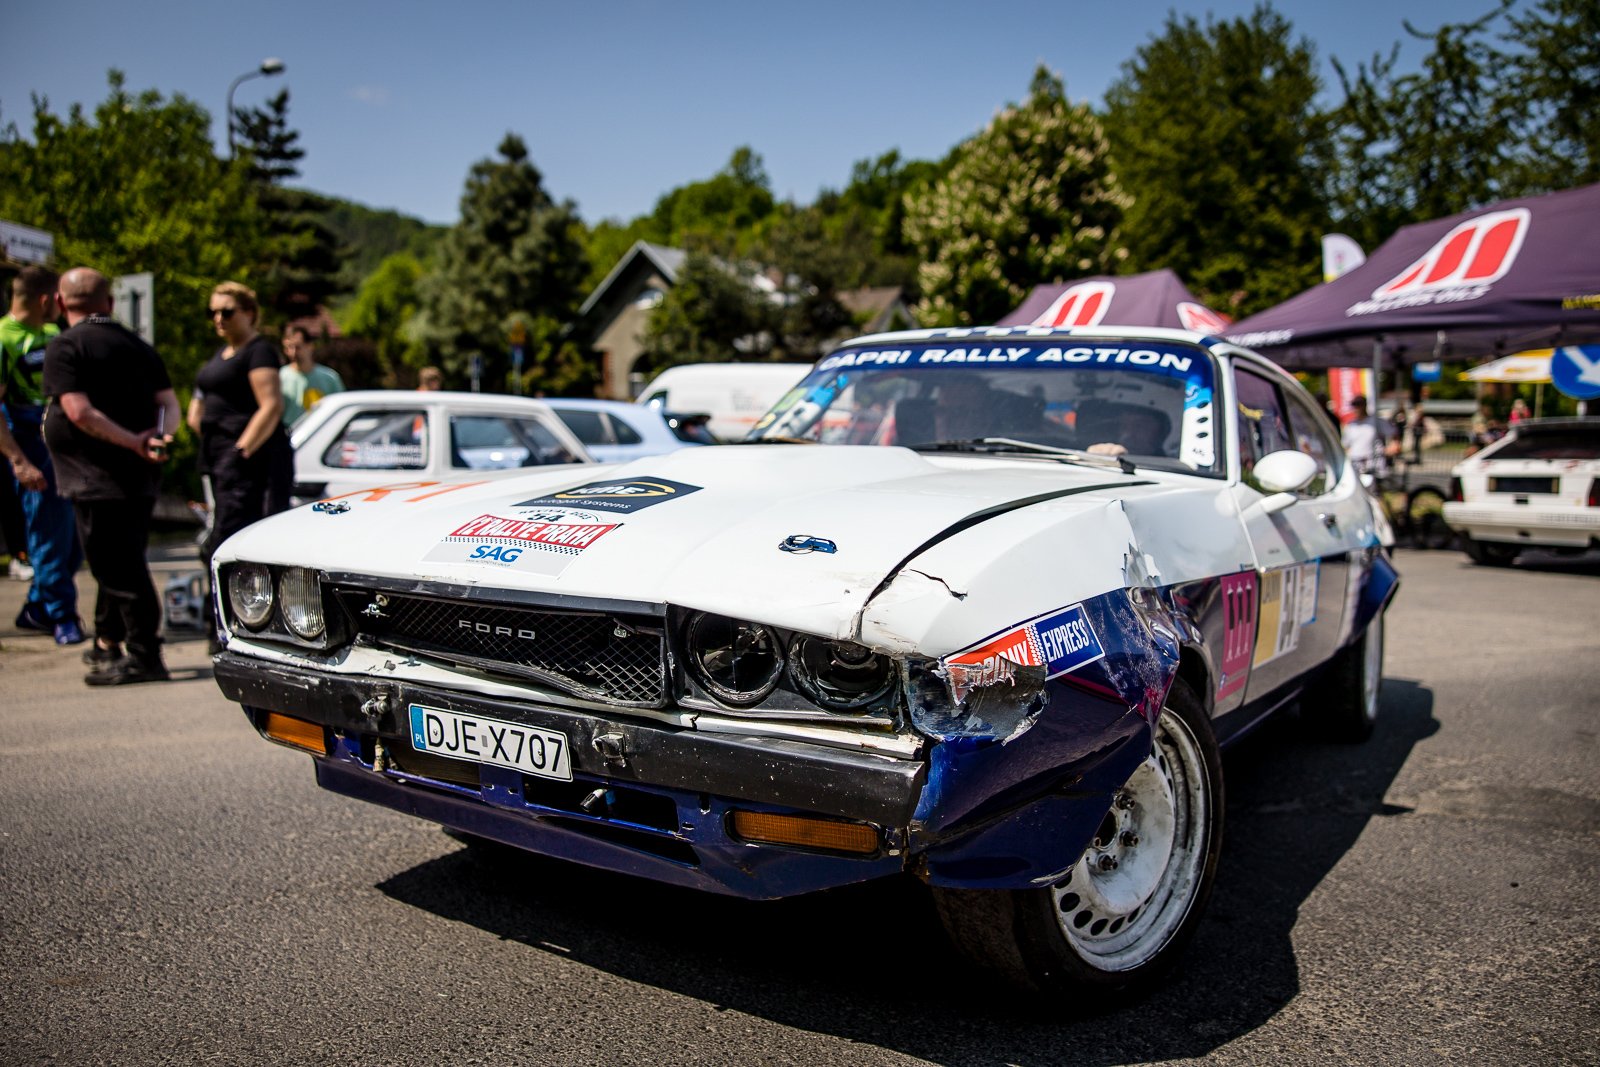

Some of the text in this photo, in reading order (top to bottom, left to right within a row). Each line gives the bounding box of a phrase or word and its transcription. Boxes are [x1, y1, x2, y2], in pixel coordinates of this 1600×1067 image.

[819, 348, 1192, 371] CAPRI RALLY ACTION
[474, 518, 545, 538] RALLYE
[532, 523, 606, 546] PRAHA
[470, 545, 523, 562] SAG
[459, 619, 535, 639] FORD
[1041, 618, 1090, 663] EXPRESS
[415, 733, 425, 744] PL
[426, 714, 563, 772] DJE X707
